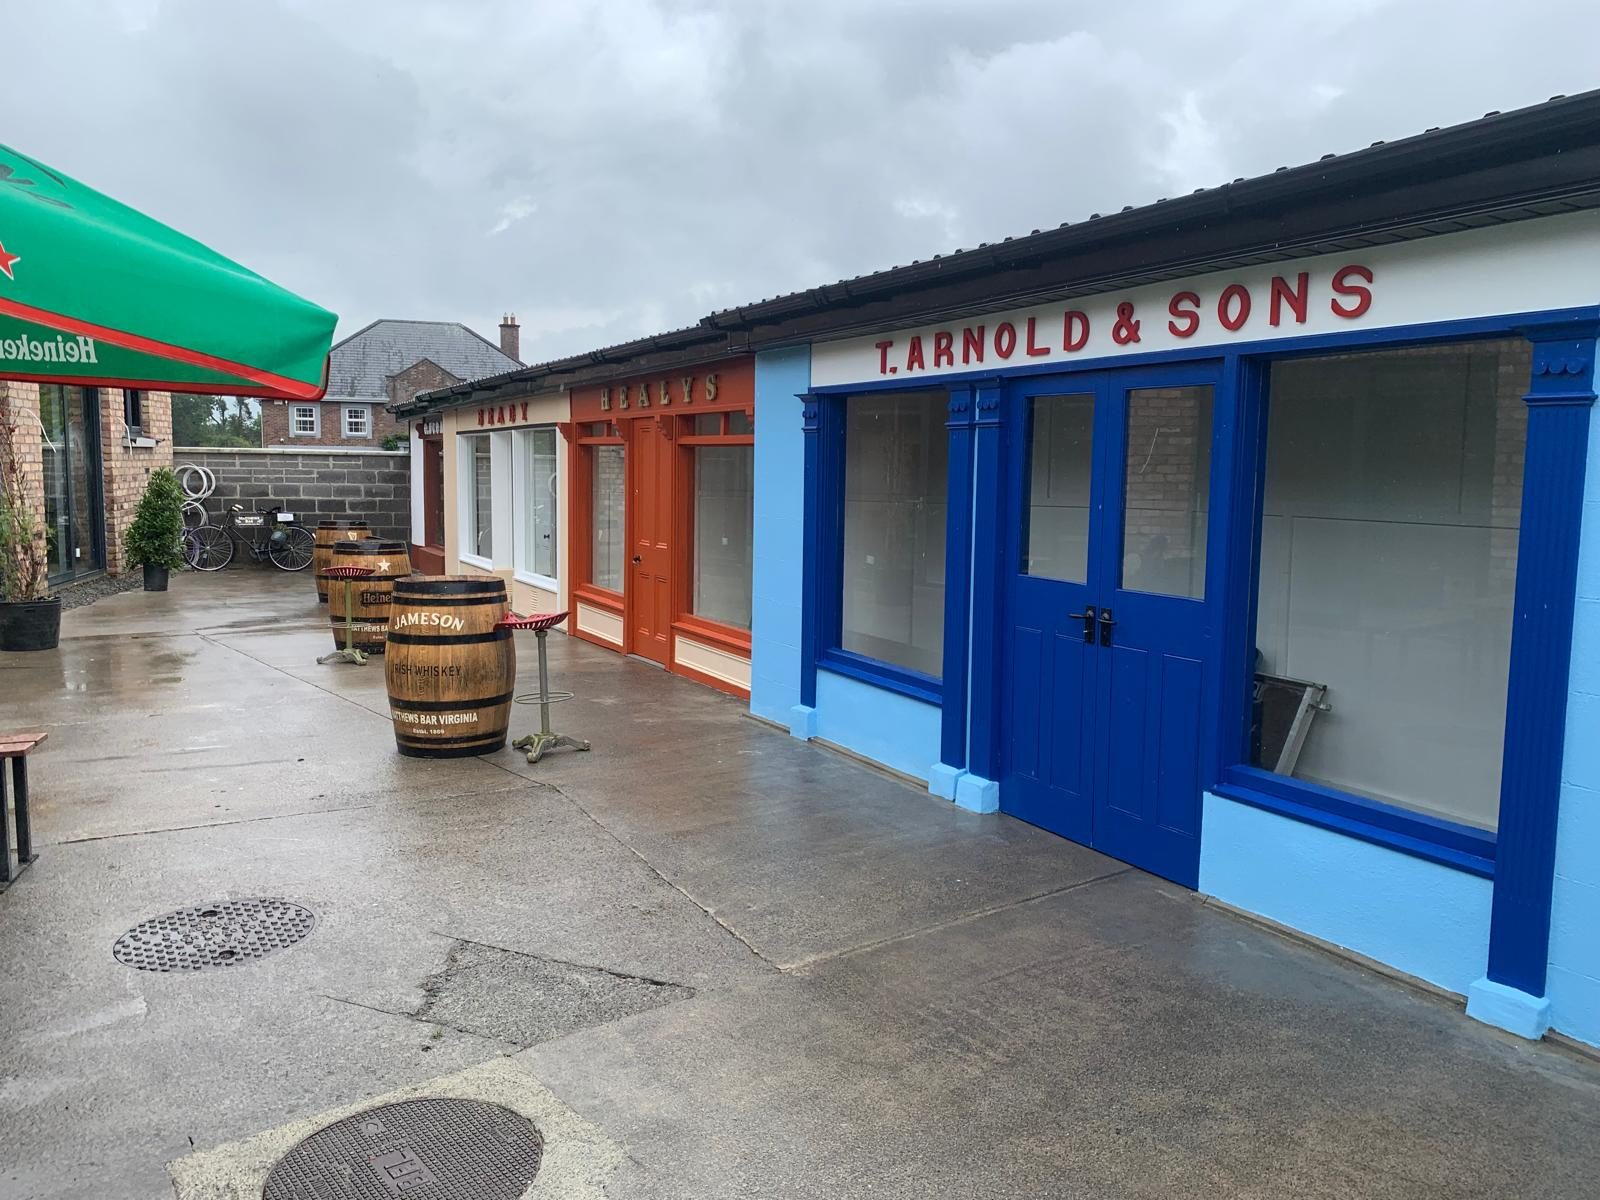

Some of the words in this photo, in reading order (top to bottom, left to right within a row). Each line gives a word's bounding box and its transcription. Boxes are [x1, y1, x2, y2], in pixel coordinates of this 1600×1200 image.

[1112, 301, 1141, 345] &
[1168, 264, 1374, 338] SONS
[601, 374, 719, 411] HEALYS
[477, 401, 529, 428] BRADY
[394, 612, 465, 632] JAMESON
[392, 663, 412, 676] IRISH
[415, 665, 462, 677] WHISKEY
[420, 714, 438, 726] BAR
[439, 712, 478, 725] VIRGINIA
